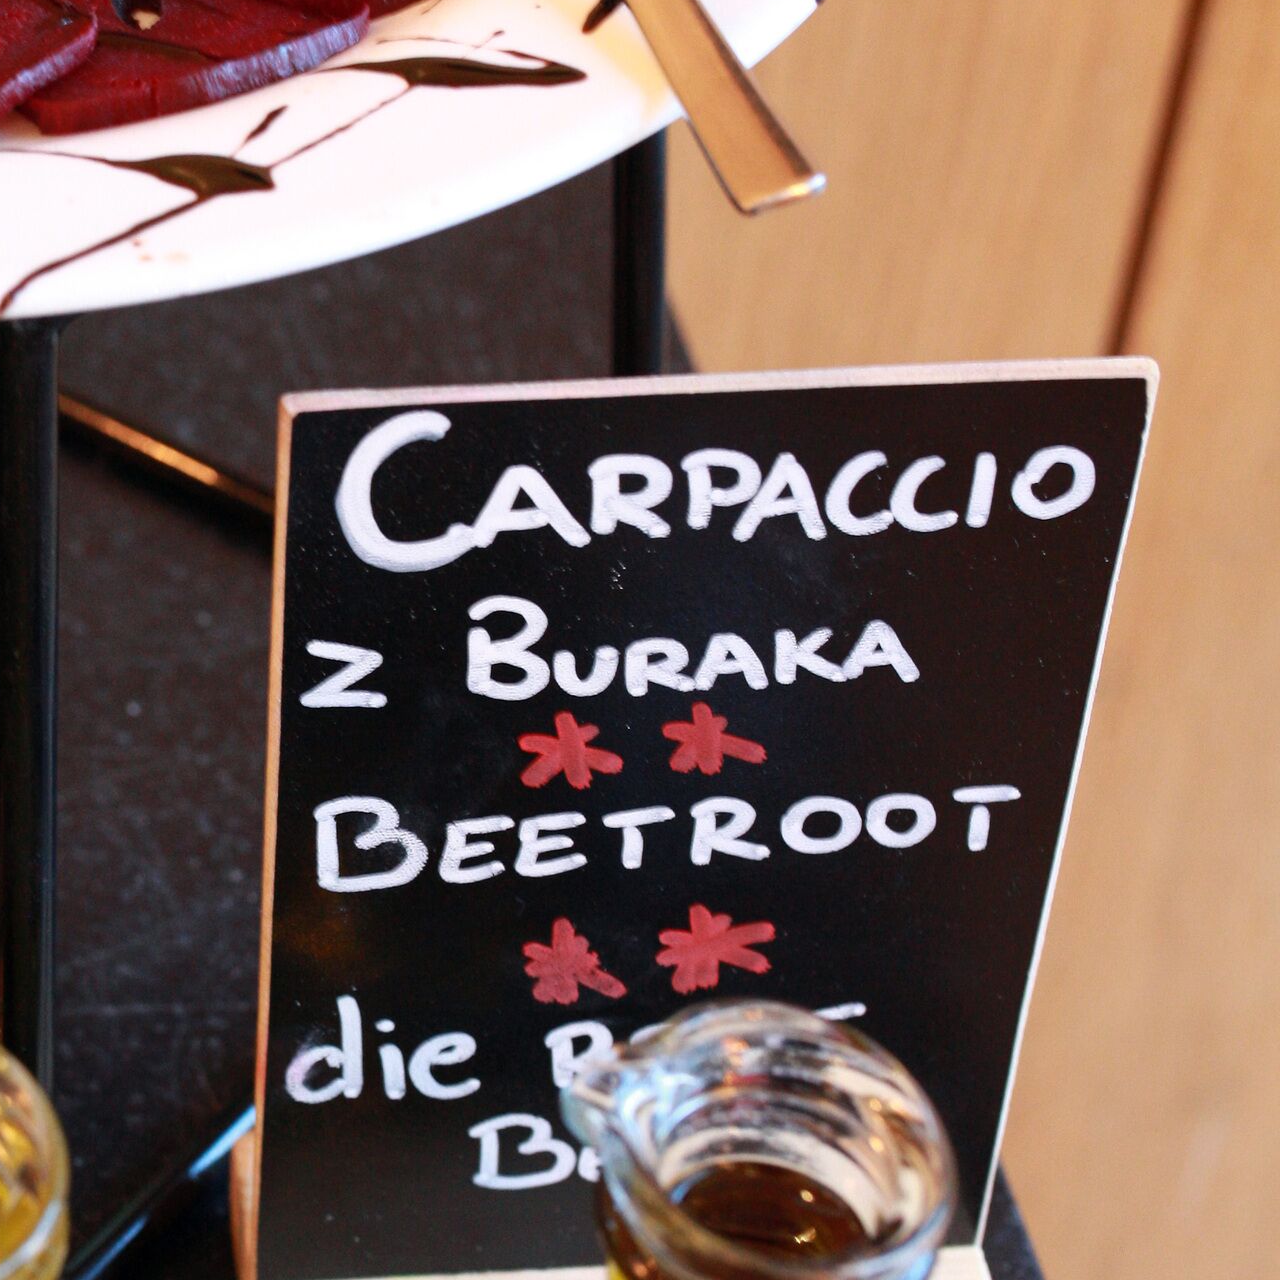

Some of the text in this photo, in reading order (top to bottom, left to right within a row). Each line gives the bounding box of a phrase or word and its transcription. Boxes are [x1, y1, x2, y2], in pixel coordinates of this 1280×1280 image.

[334, 409, 1096, 572] CARPACCIO
[466, 595, 920, 700] BURAKA
[313, 784, 1021, 892] BEETROOT
[285, 994, 481, 1104] die
